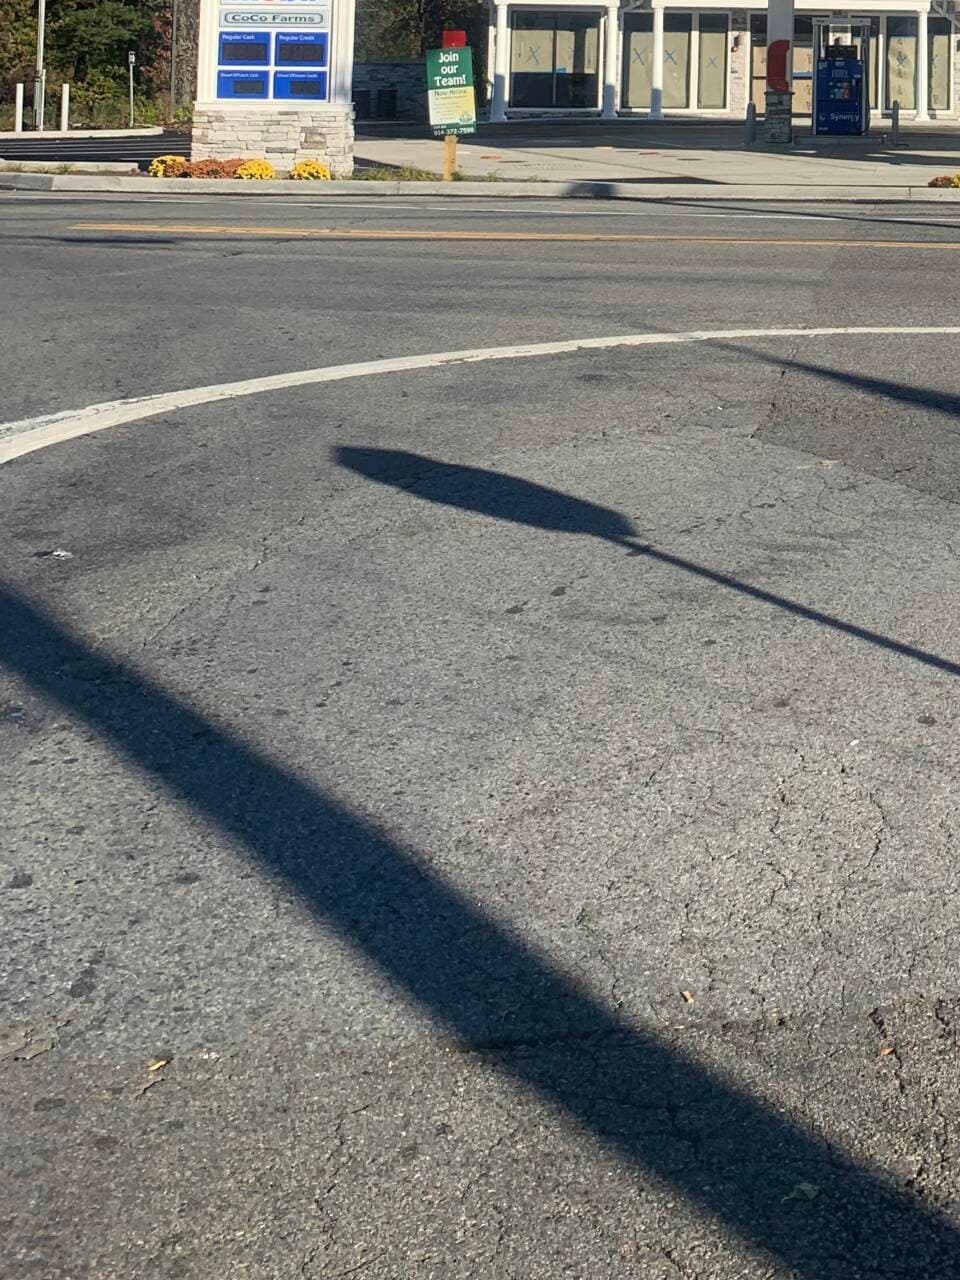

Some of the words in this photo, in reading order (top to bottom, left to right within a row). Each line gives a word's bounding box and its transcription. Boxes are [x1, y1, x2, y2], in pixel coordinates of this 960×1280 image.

[232, 14, 268, 22] CoCo
[272, 14, 315, 22] Farms
[438, 51, 459, 63] Join
[441, 65, 459, 74] our
[434, 74, 466, 86] Team!
